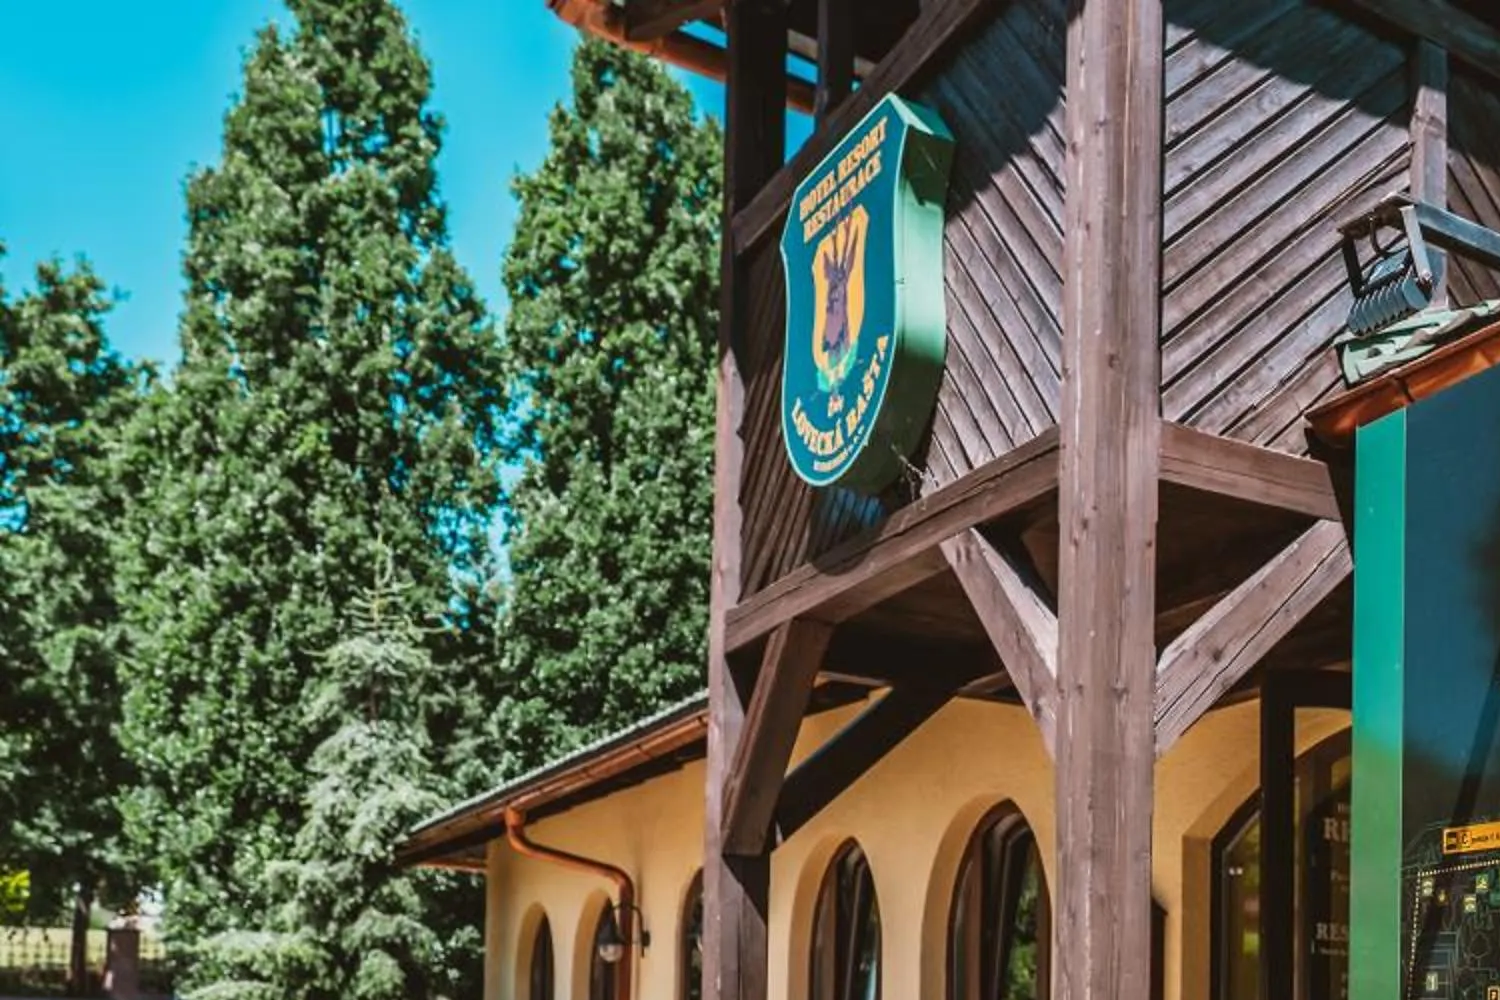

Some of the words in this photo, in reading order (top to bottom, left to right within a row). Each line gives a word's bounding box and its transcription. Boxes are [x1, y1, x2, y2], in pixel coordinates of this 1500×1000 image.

[799, 169, 837, 222] HOTEL
[838, 116, 888, 184] RESORT
[804, 149, 882, 243] RESTAURACE
